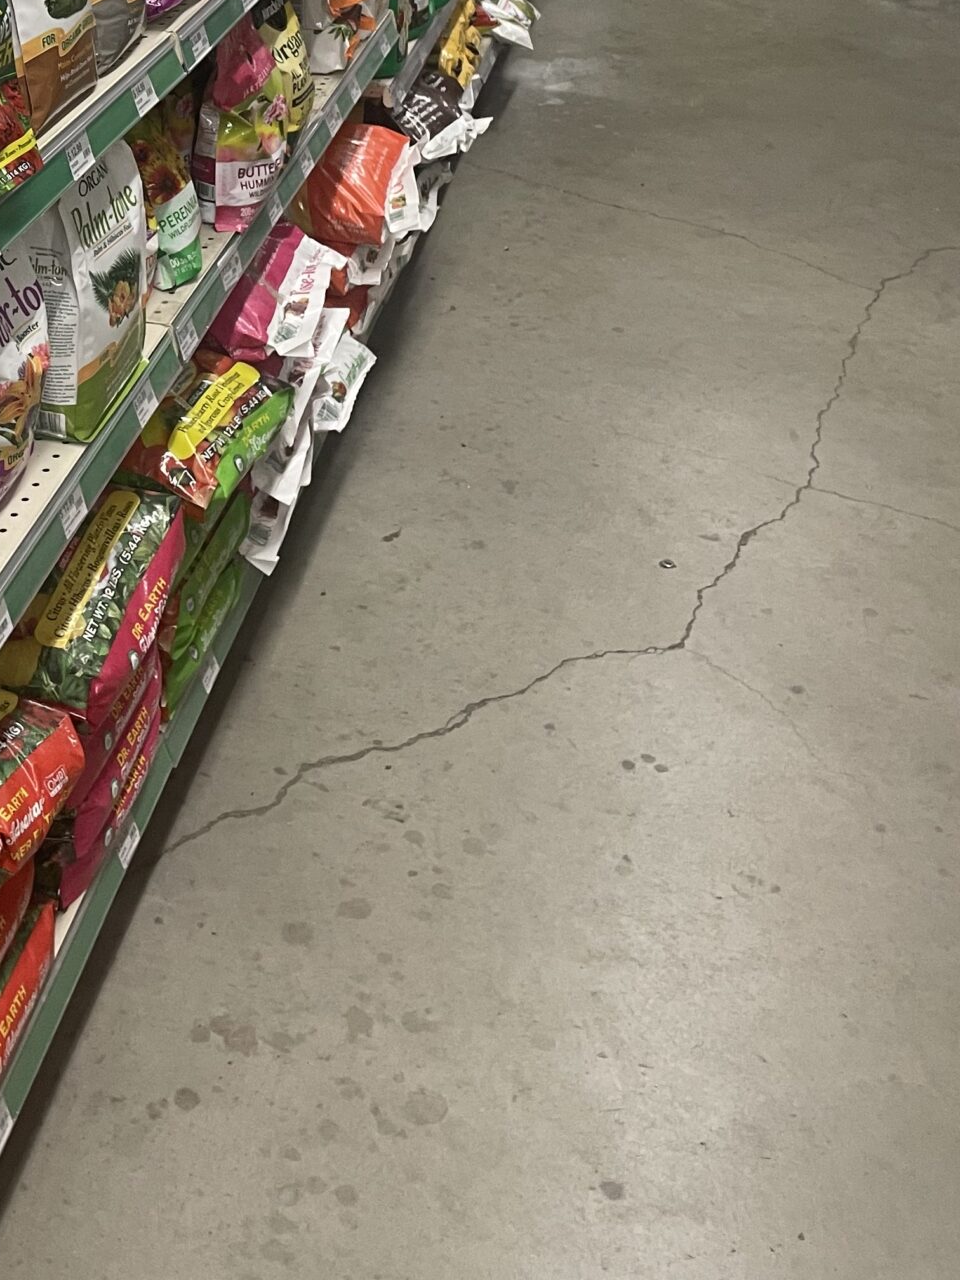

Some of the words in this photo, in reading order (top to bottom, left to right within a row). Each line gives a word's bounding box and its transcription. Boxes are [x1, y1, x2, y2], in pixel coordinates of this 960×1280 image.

[41, 32, 56, 49] FOR
[70, 182, 138, 251] Palm-tone
[200, 442, 218, 462] NET
[81, 618, 101, 643] NET
[92, 599, 108, 624] WT.
[119, 532, 142, 566] (5.44
[137, 577, 169, 620] EARTH
[46, 594, 62, 622] Citrus
